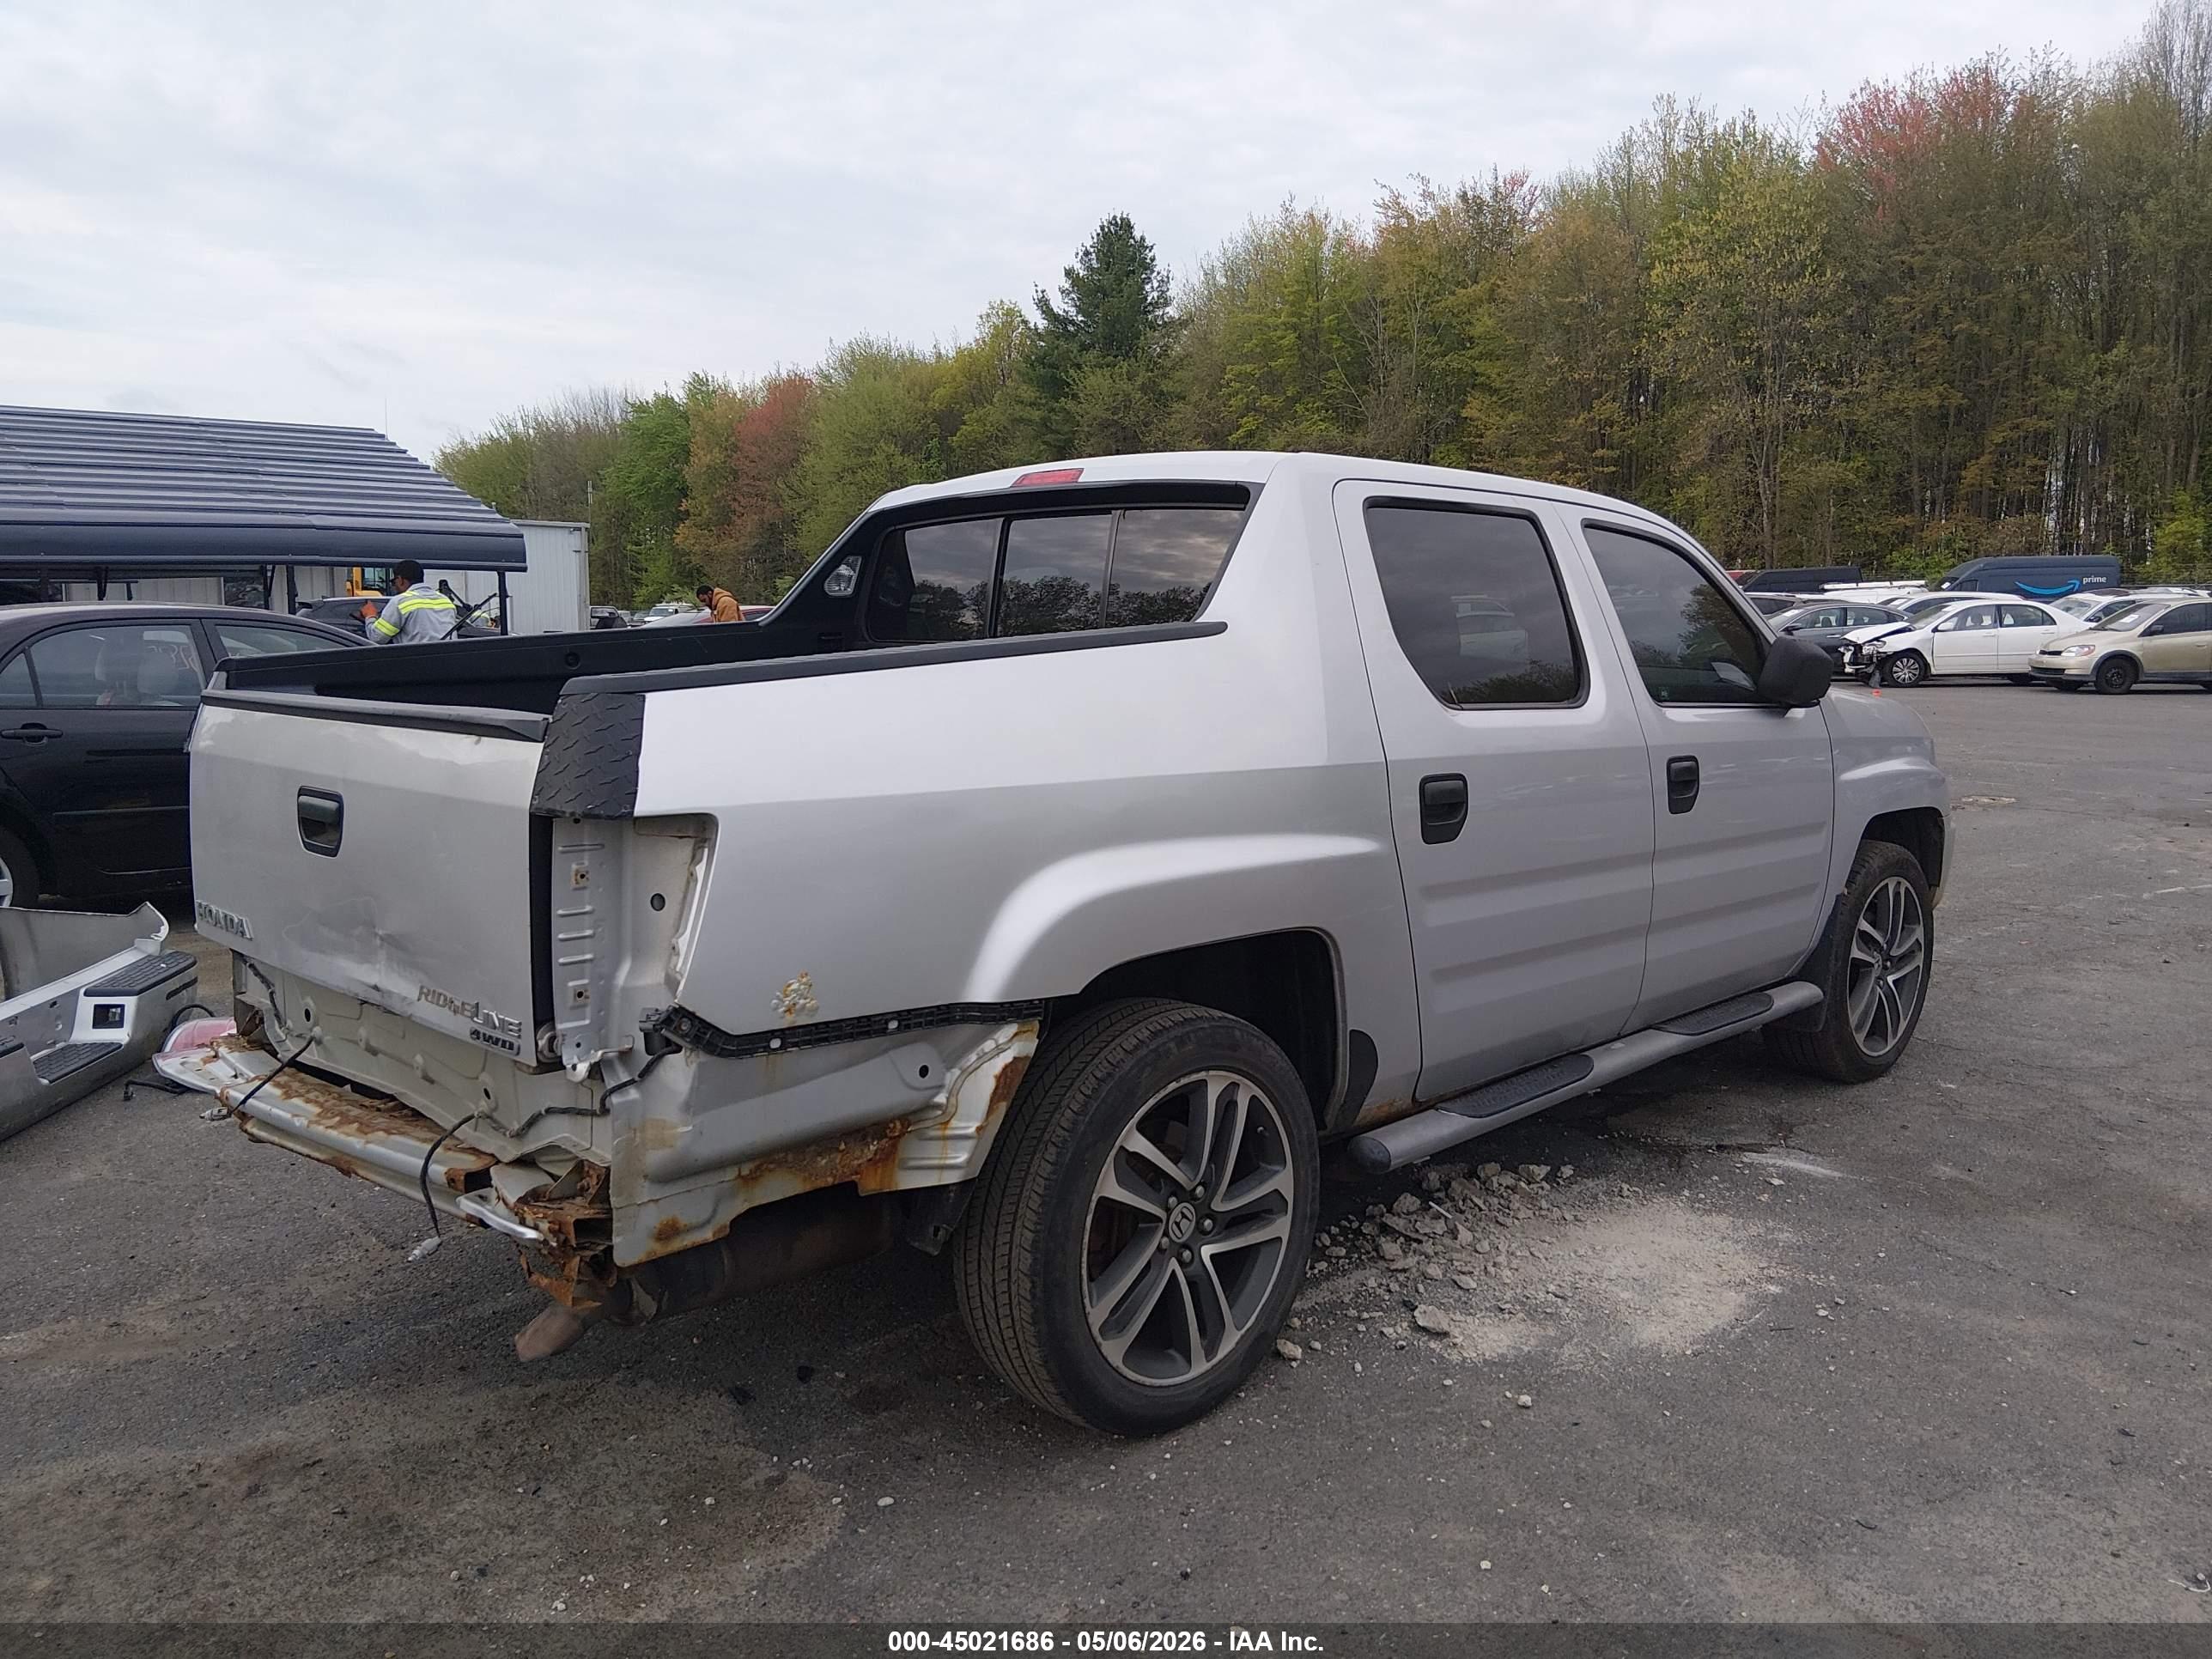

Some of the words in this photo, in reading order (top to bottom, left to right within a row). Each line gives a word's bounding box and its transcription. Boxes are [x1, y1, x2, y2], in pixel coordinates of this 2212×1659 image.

[2082, 575, 2107, 585] prime
[196, 899, 254, 941] HONDA
[417, 983, 522, 1040] RIDGELINE
[470, 1028, 517, 1052] 4WD
